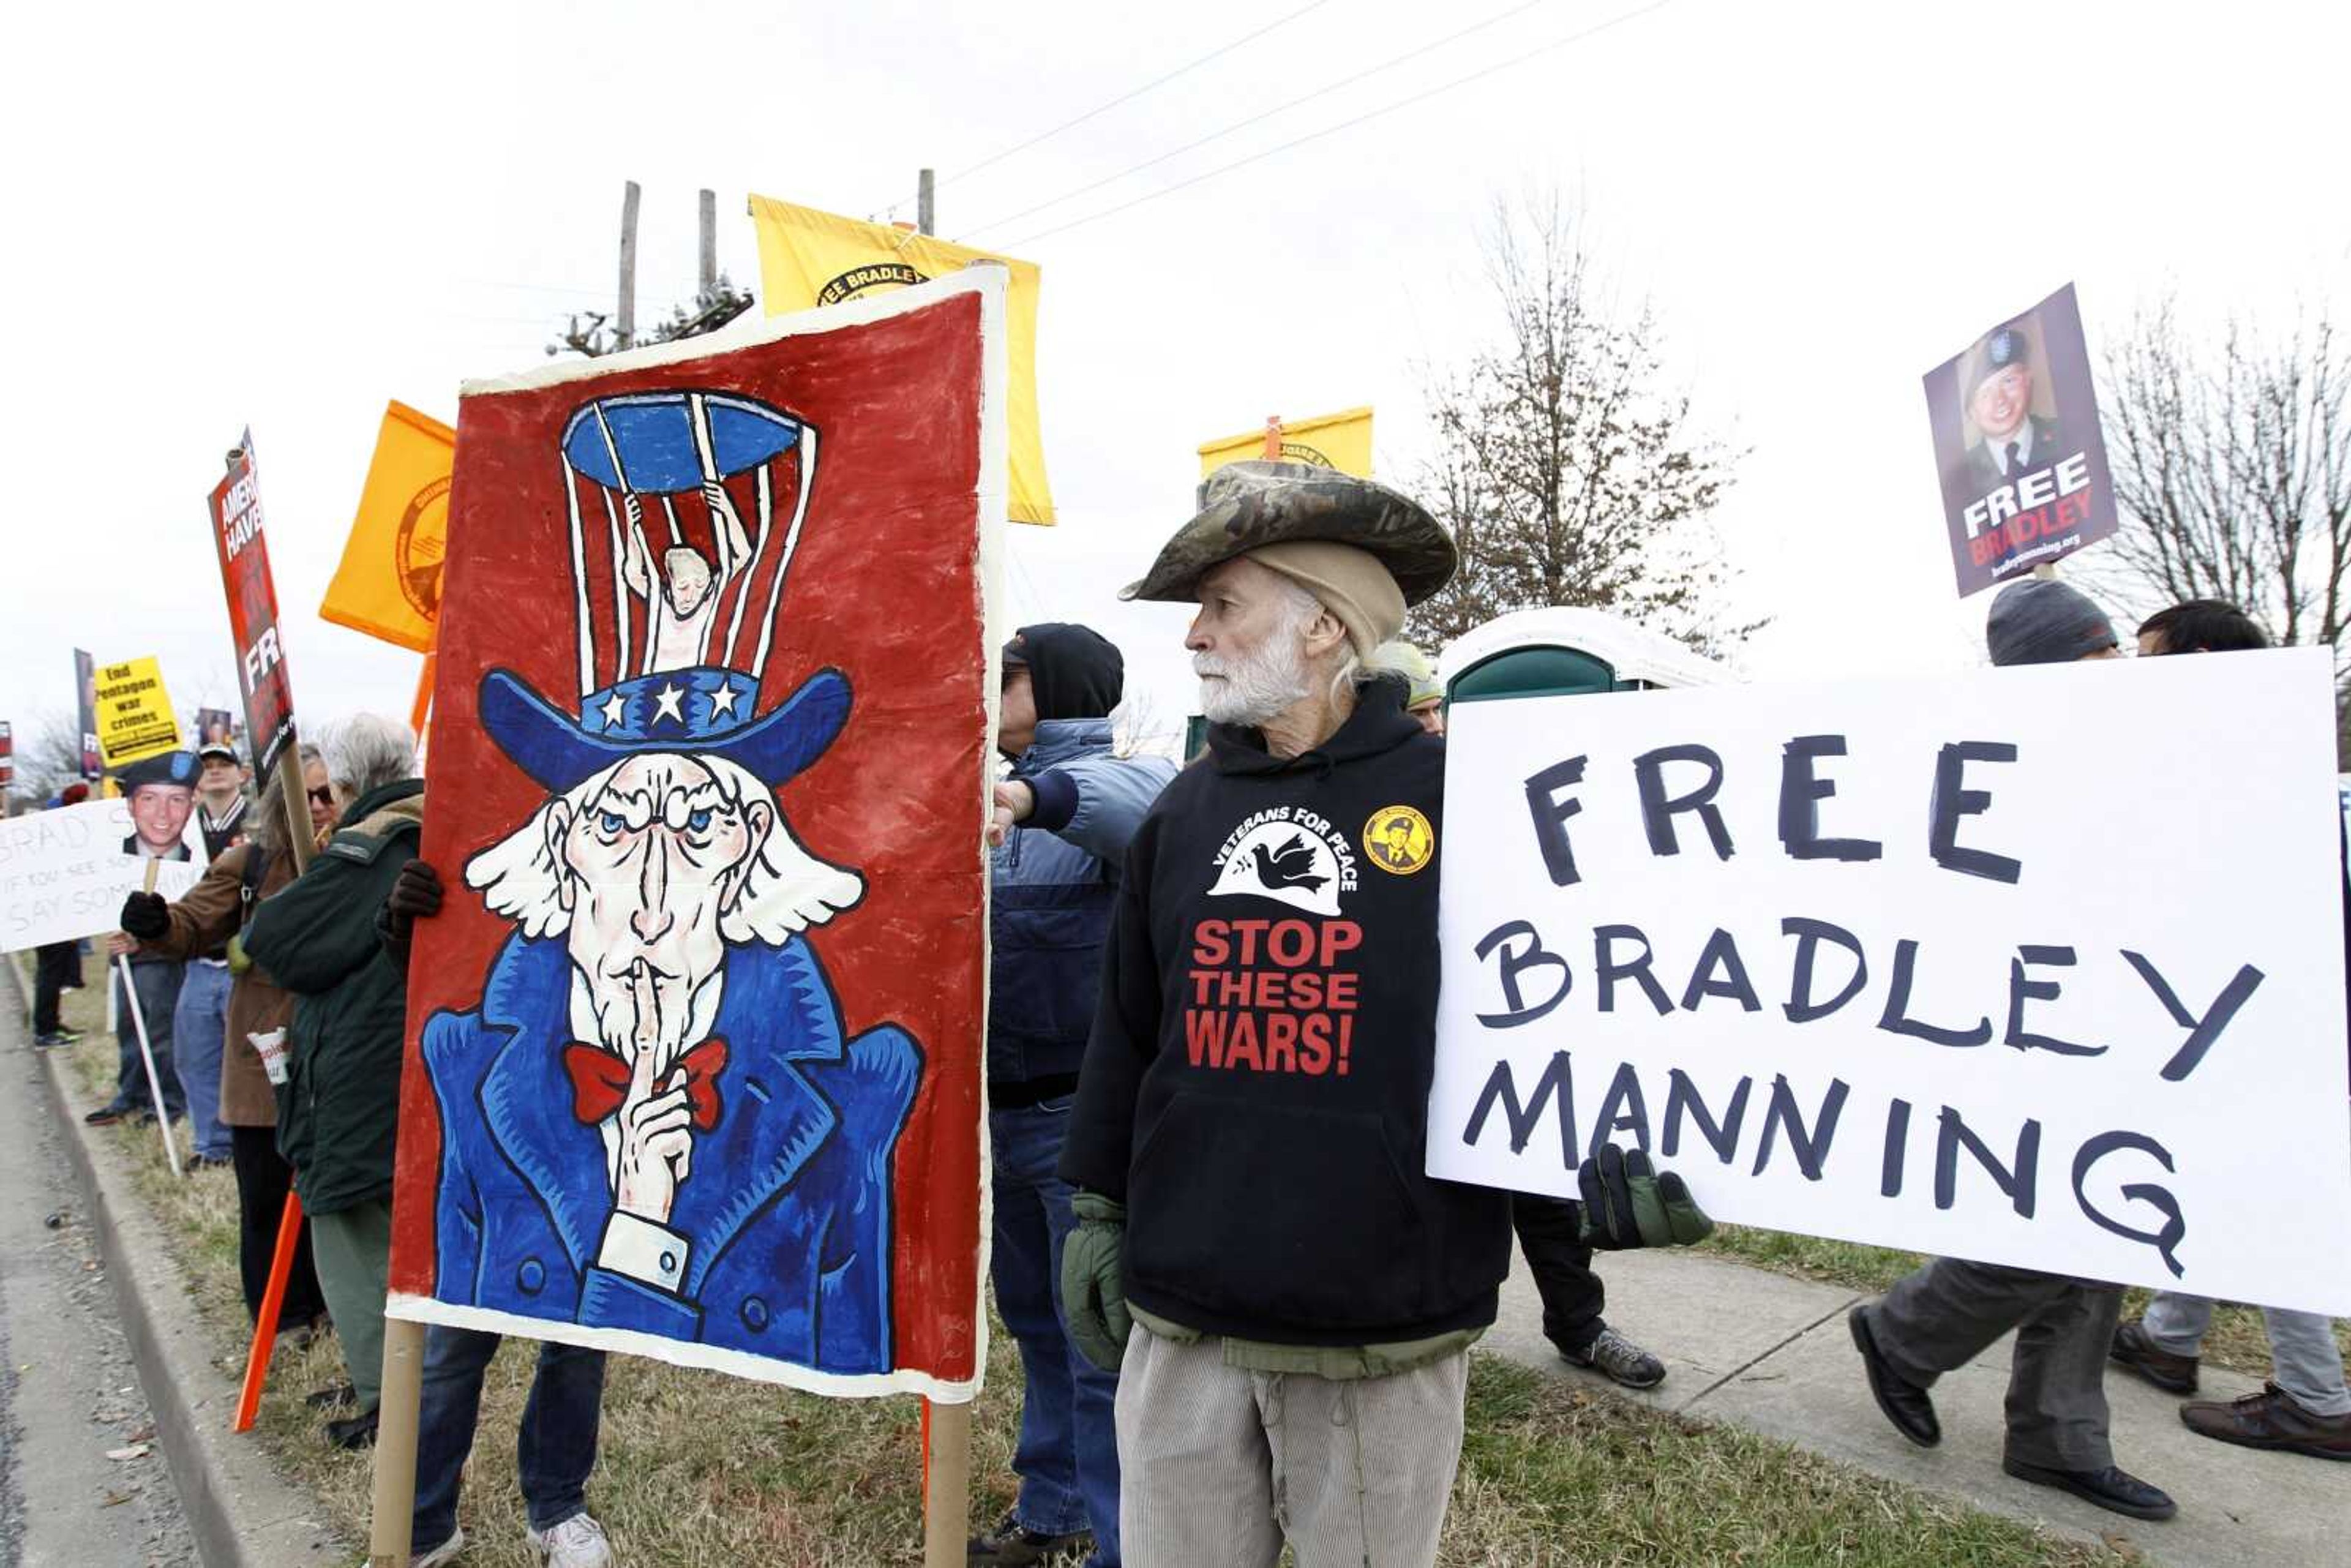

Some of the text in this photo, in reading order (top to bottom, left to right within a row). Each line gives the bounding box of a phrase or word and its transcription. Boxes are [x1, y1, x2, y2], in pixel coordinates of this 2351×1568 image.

[1963, 451, 2090, 539] FREE
[1967, 486, 2094, 567] BRADLEY
[106, 665, 130, 681] End
[110, 711, 159, 731] crimes
[115, 698, 141, 718] war
[1524, 735, 2022, 885] FREE
[1212, 806, 1290, 866] VETERANS
[1293, 808, 1331, 837] FOR
[1327, 831, 1357, 892] PEACE
[10, 893, 60, 931] SAY
[1193, 919, 1363, 967] STOP
[1189, 970, 1359, 1010] THESE
[1474, 917, 2266, 1082] BRADLEY
[1186, 1010, 1352, 1076] WARS!
[1463, 1049, 2186, 1280] MANNING
